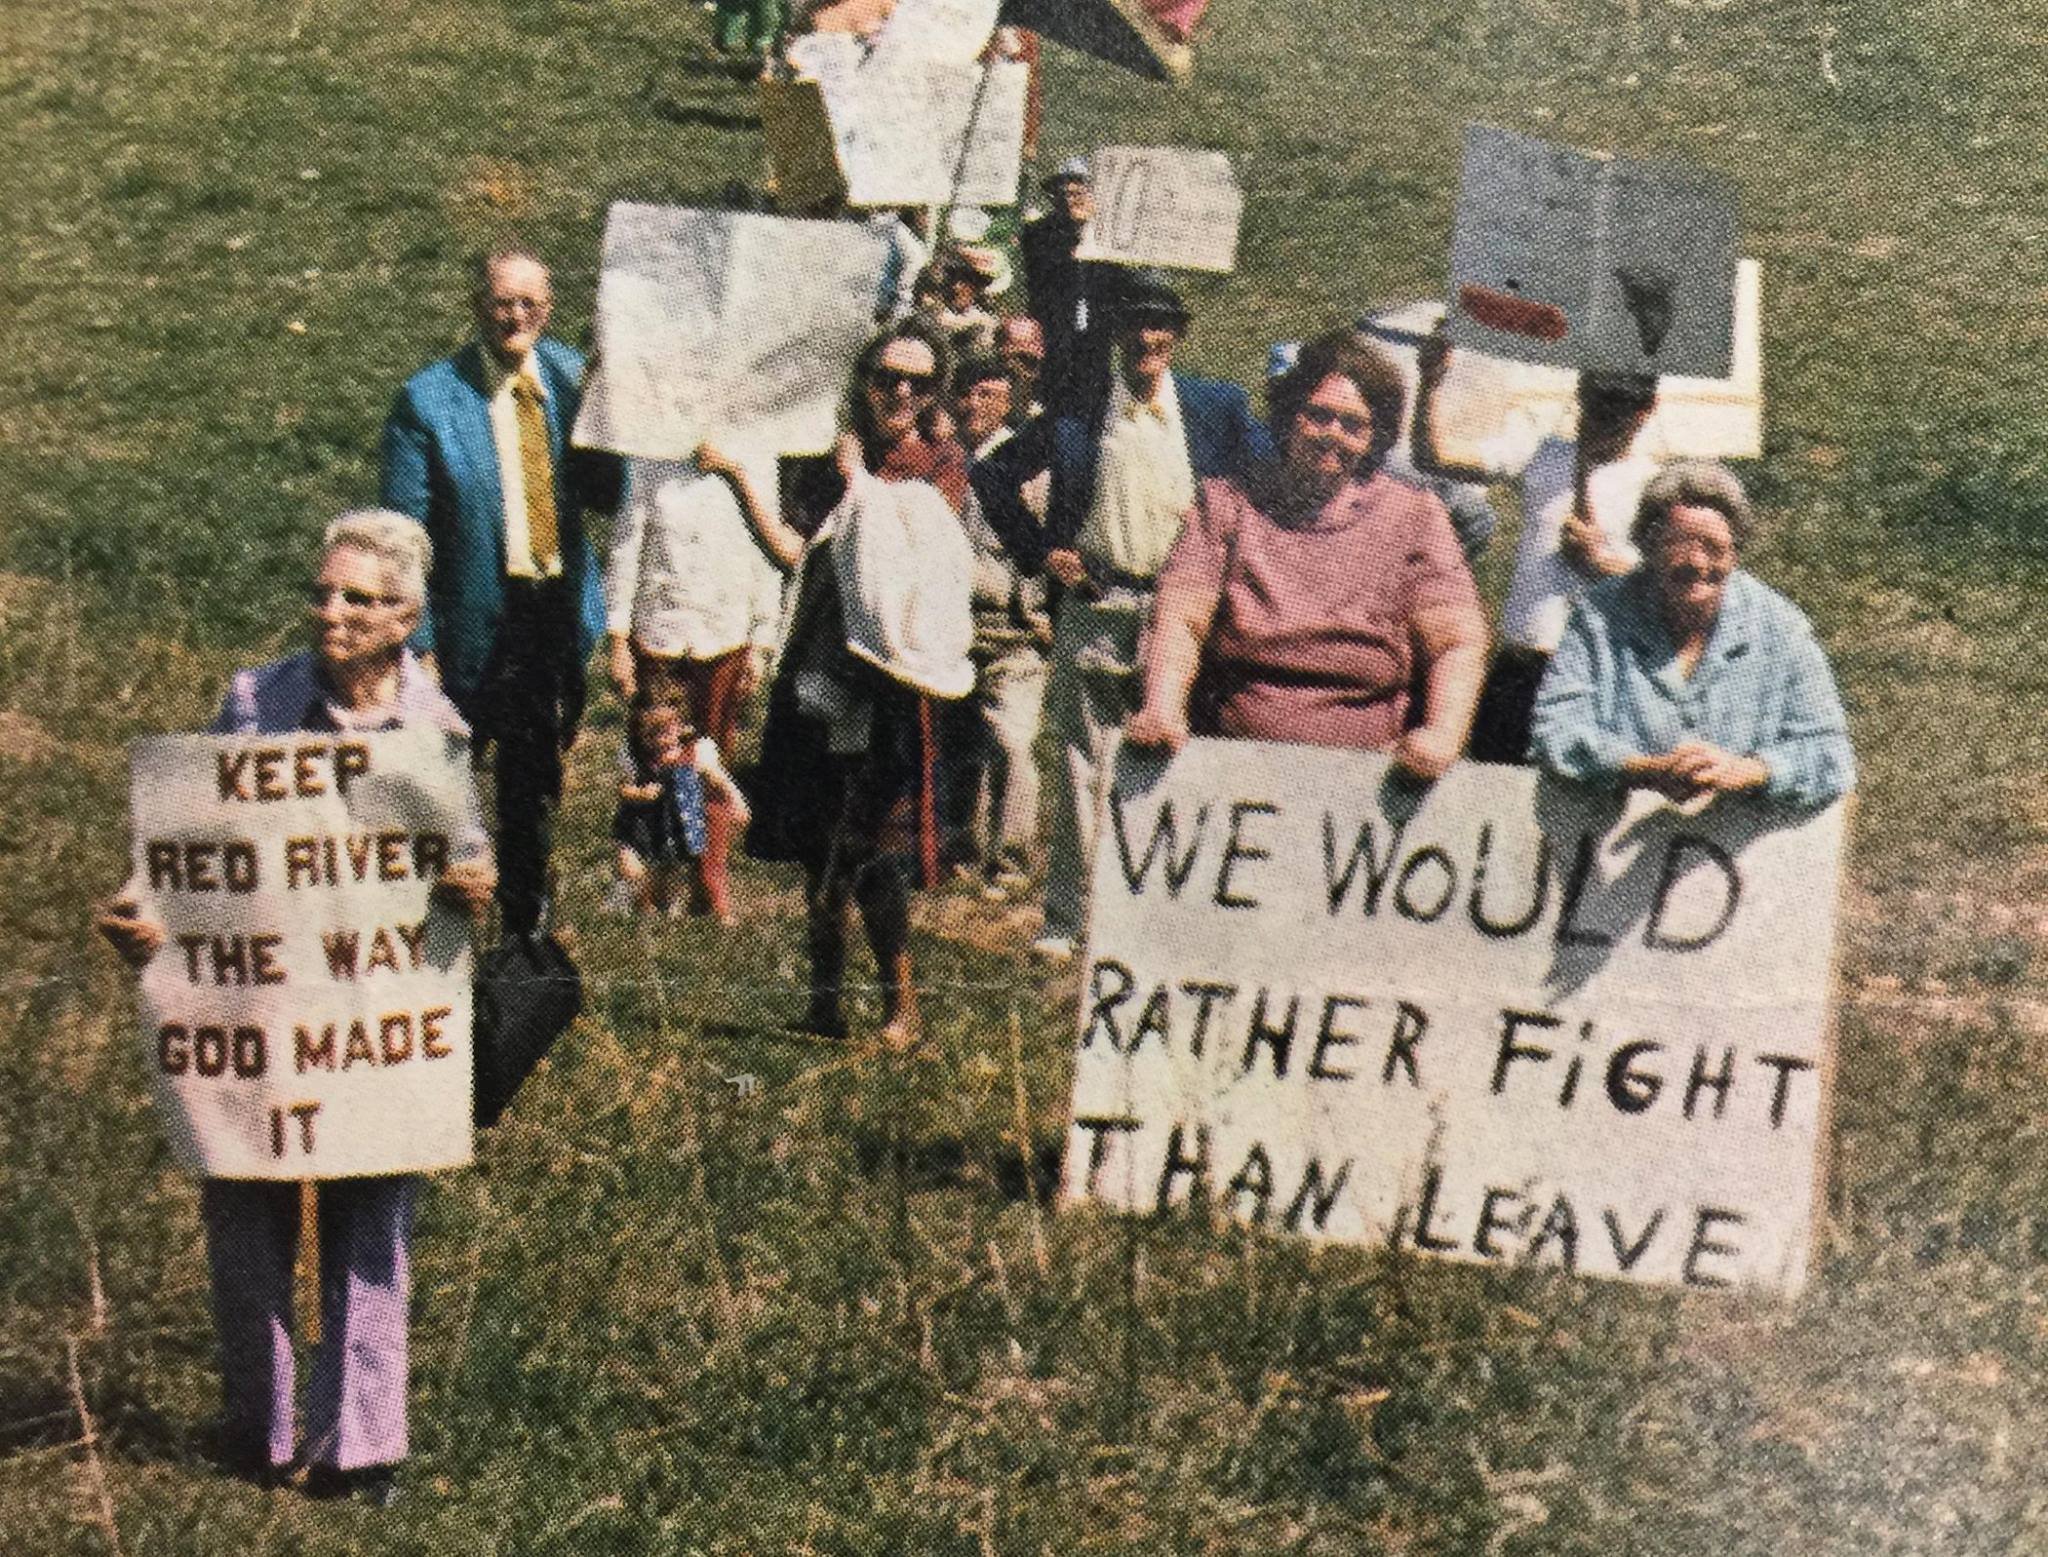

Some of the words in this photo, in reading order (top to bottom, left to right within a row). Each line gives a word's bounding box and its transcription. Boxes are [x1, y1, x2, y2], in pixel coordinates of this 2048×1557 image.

[217, 741, 370, 801] KEEP
[146, 837, 257, 893] RED
[286, 830, 450, 889] RIVER
[1108, 799, 1280, 909] WE
[1323, 810, 1741, 953] WOULD
[175, 932, 286, 985] THE
[320, 922, 424, 980] WAY
[158, 1021, 267, 1078] GOD
[294, 1006, 453, 1074] MADE
[1082, 960, 1429, 1087] RATHER
[269, 1100, 321, 1159] IT
[1074, 1114, 1354, 1232] THAN
[1413, 1160, 1747, 1289] LEAVE
